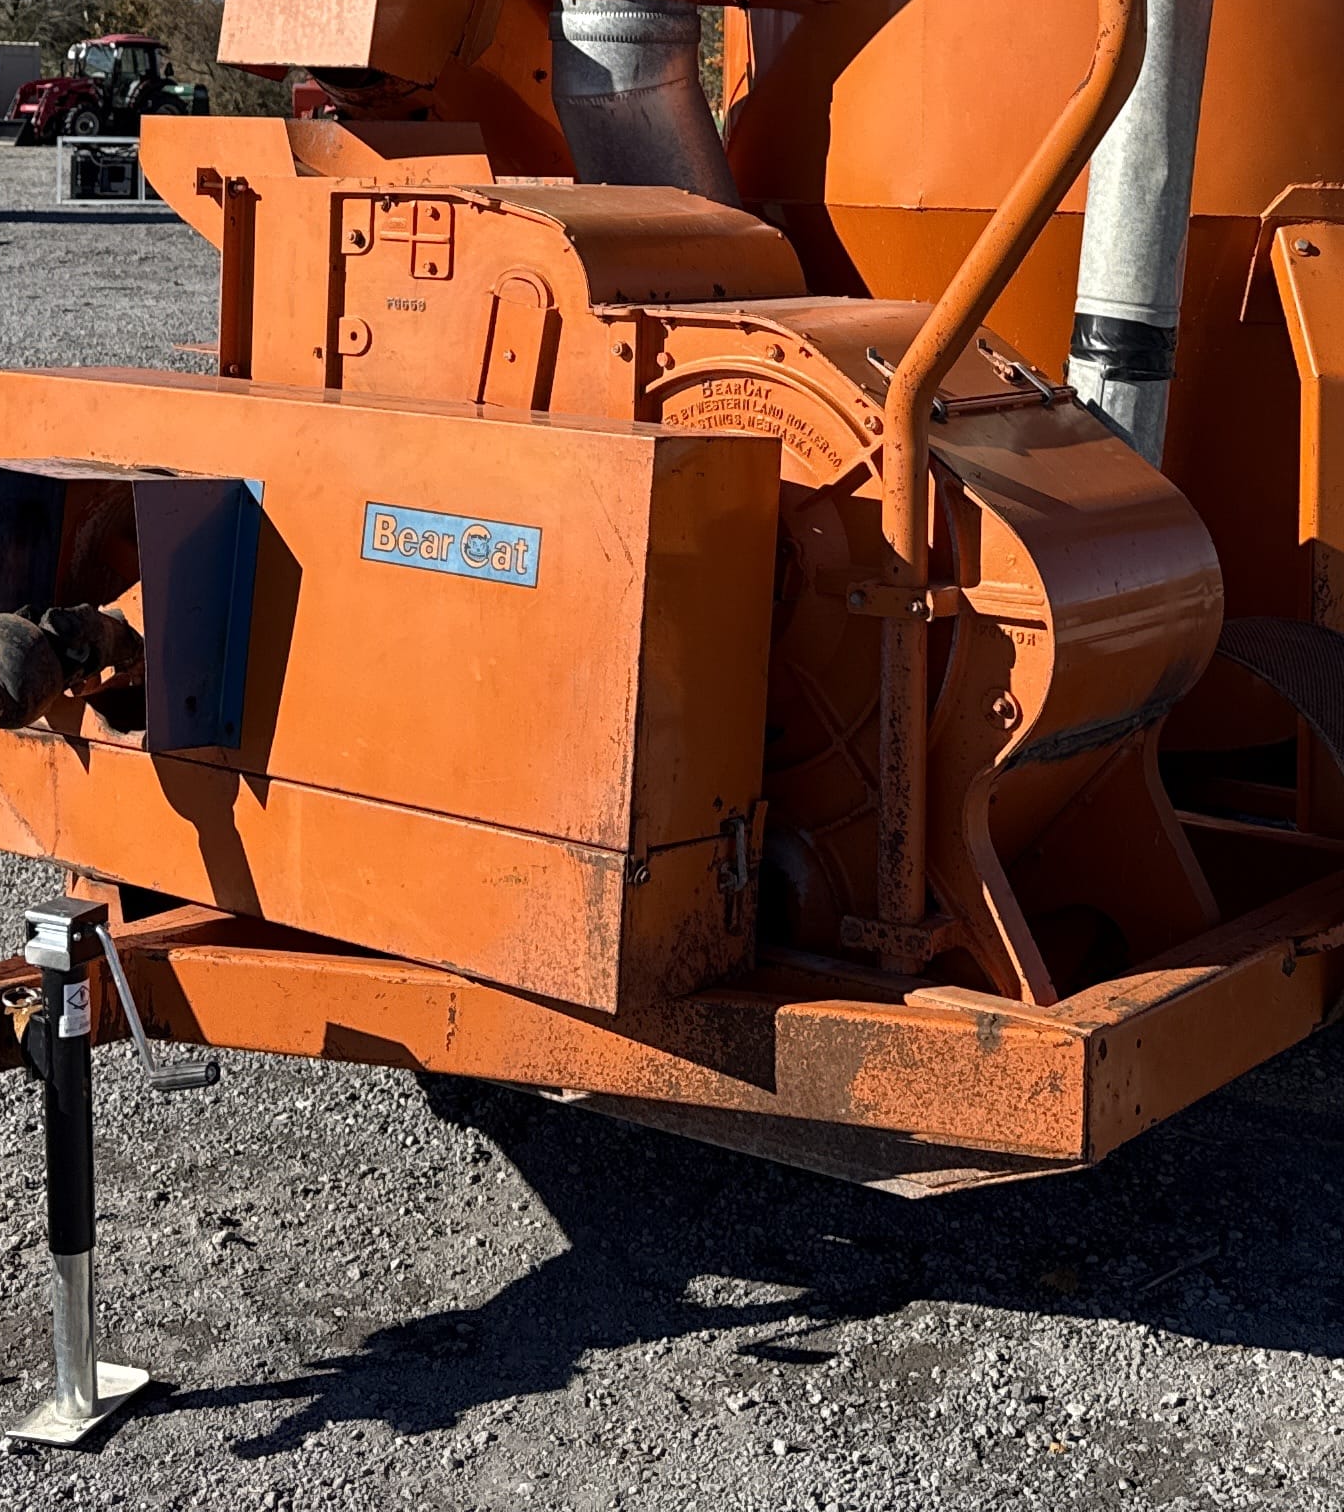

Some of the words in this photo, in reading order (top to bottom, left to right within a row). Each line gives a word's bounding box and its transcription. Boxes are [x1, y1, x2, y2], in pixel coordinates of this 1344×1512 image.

[696, 397, 751, 415] WESTERN
[752, 400, 784, 420] LAND
[786, 413, 830, 454] ROLLER
[747, 415, 813, 459] NEBRASKA
[372, 512, 455, 561] Bear
[459, 523, 528, 575] Cat
